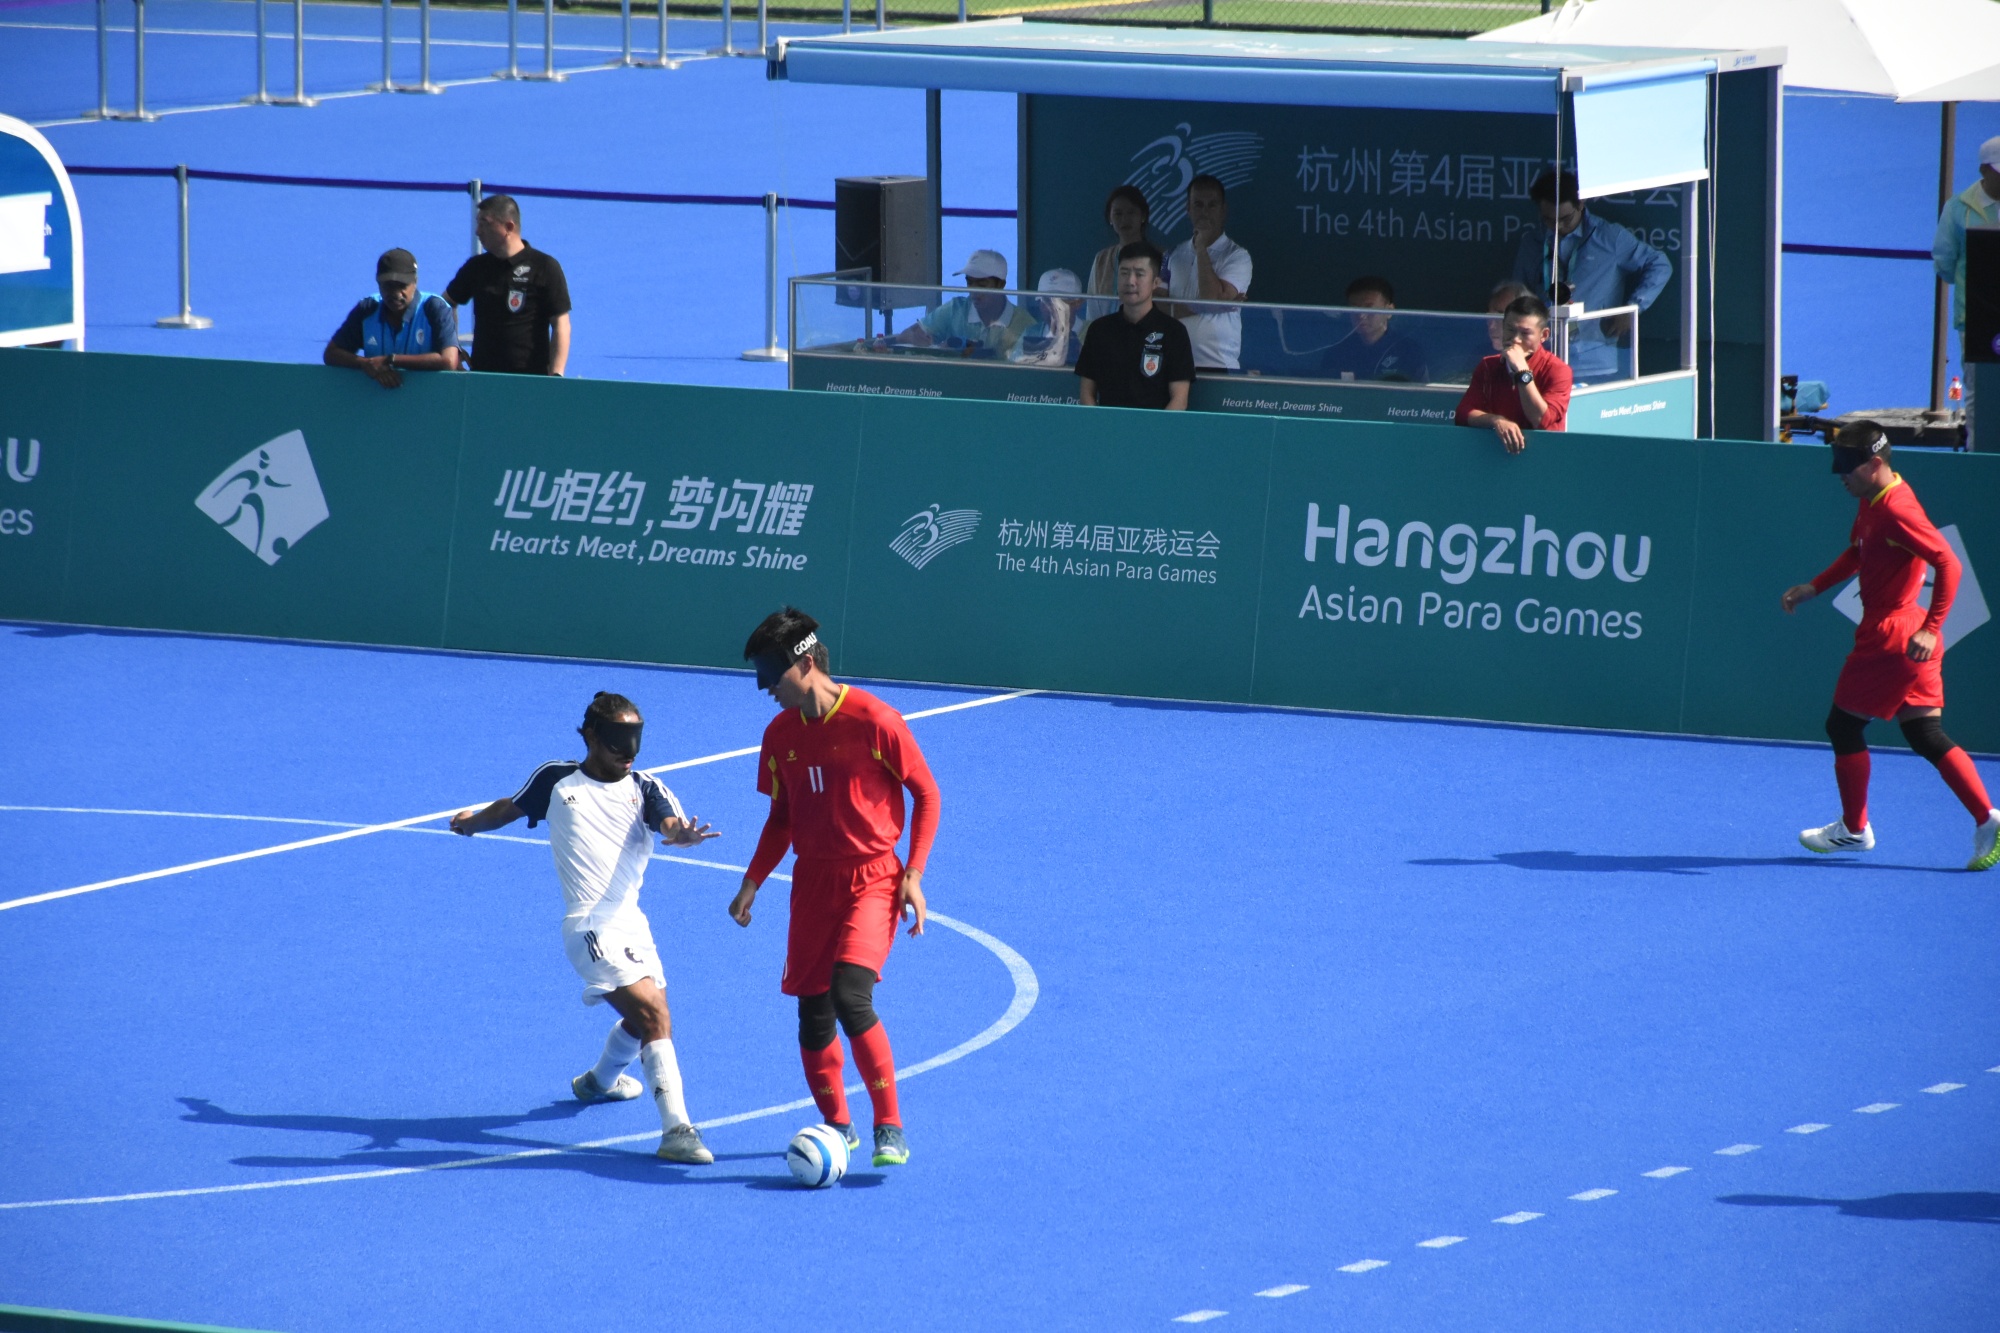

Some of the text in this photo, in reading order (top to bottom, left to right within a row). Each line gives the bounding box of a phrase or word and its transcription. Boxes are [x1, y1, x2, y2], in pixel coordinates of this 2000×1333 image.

[1296, 205, 1350, 236] The
[1358, 209, 1405, 239] 4th
[1413, 212, 1493, 243] Asian
[826, 382, 856, 393] Hearts
[884, 386, 917, 396] Dreams
[919, 388, 943, 398] Shine
[1007, 392, 1037, 403] Hearts
[1222, 398, 1253, 408] Hearts
[1282, 401, 1316, 411] Dreams
[1318, 402, 1343, 413] Shine
[1387, 407, 1418, 417] Hearts
[489, 529, 570, 557] Hearts
[648, 539, 737, 567] Dreams
[742, 545, 808, 571] Shine
[998, 518, 1221, 559] 杭州第4届亚残运会
[1304, 502, 1651, 585] Hangzhou
[996, 553, 1217, 585] The 4th Asian Para Games
[1298, 584, 1643, 640] Asian Para Games
[808, 766, 824, 793] 11
